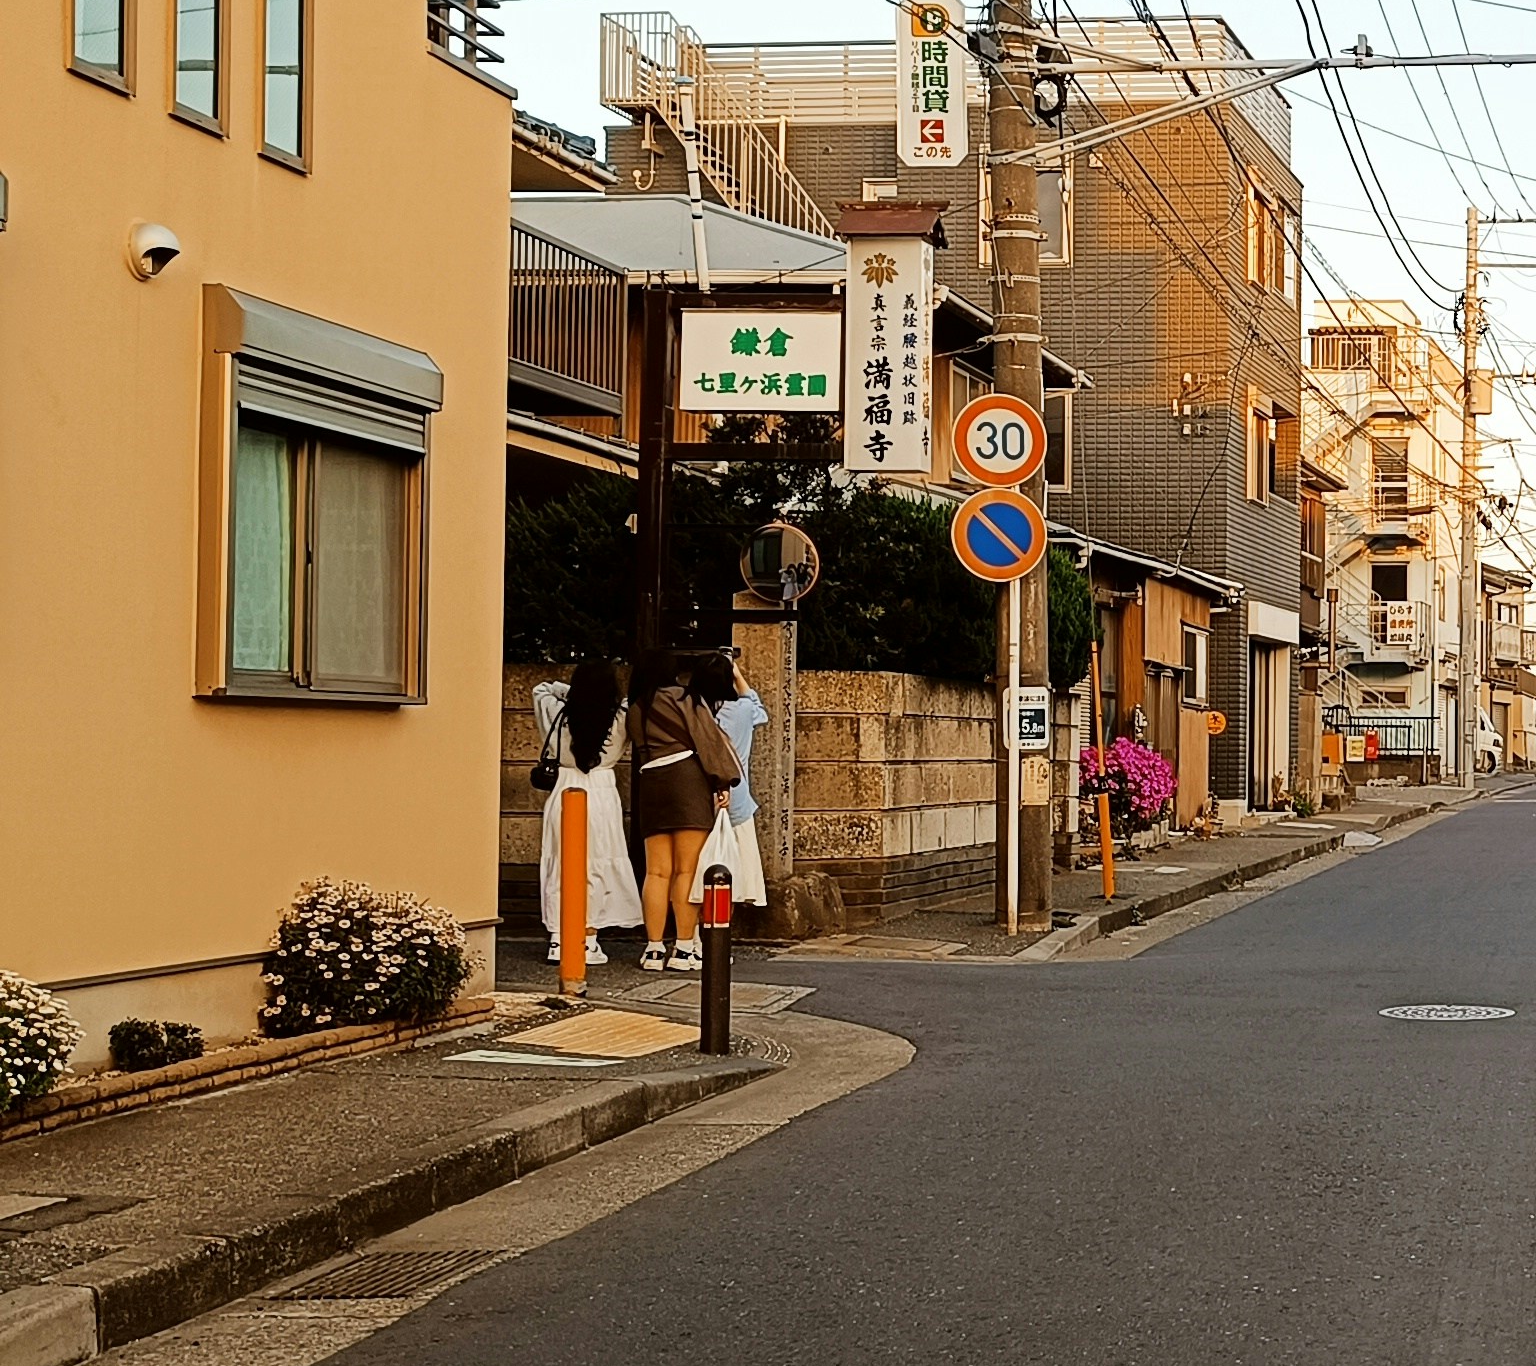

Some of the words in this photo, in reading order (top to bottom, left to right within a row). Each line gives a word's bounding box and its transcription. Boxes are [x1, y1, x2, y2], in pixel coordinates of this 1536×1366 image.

[920, 40, 949, 114] 時間貸
[913, 146, 952, 159] この先
[729, 327, 794, 357] 鎌倉
[975, 421, 1025, 461] 30
[1389, 605, 1413, 615] しらす
